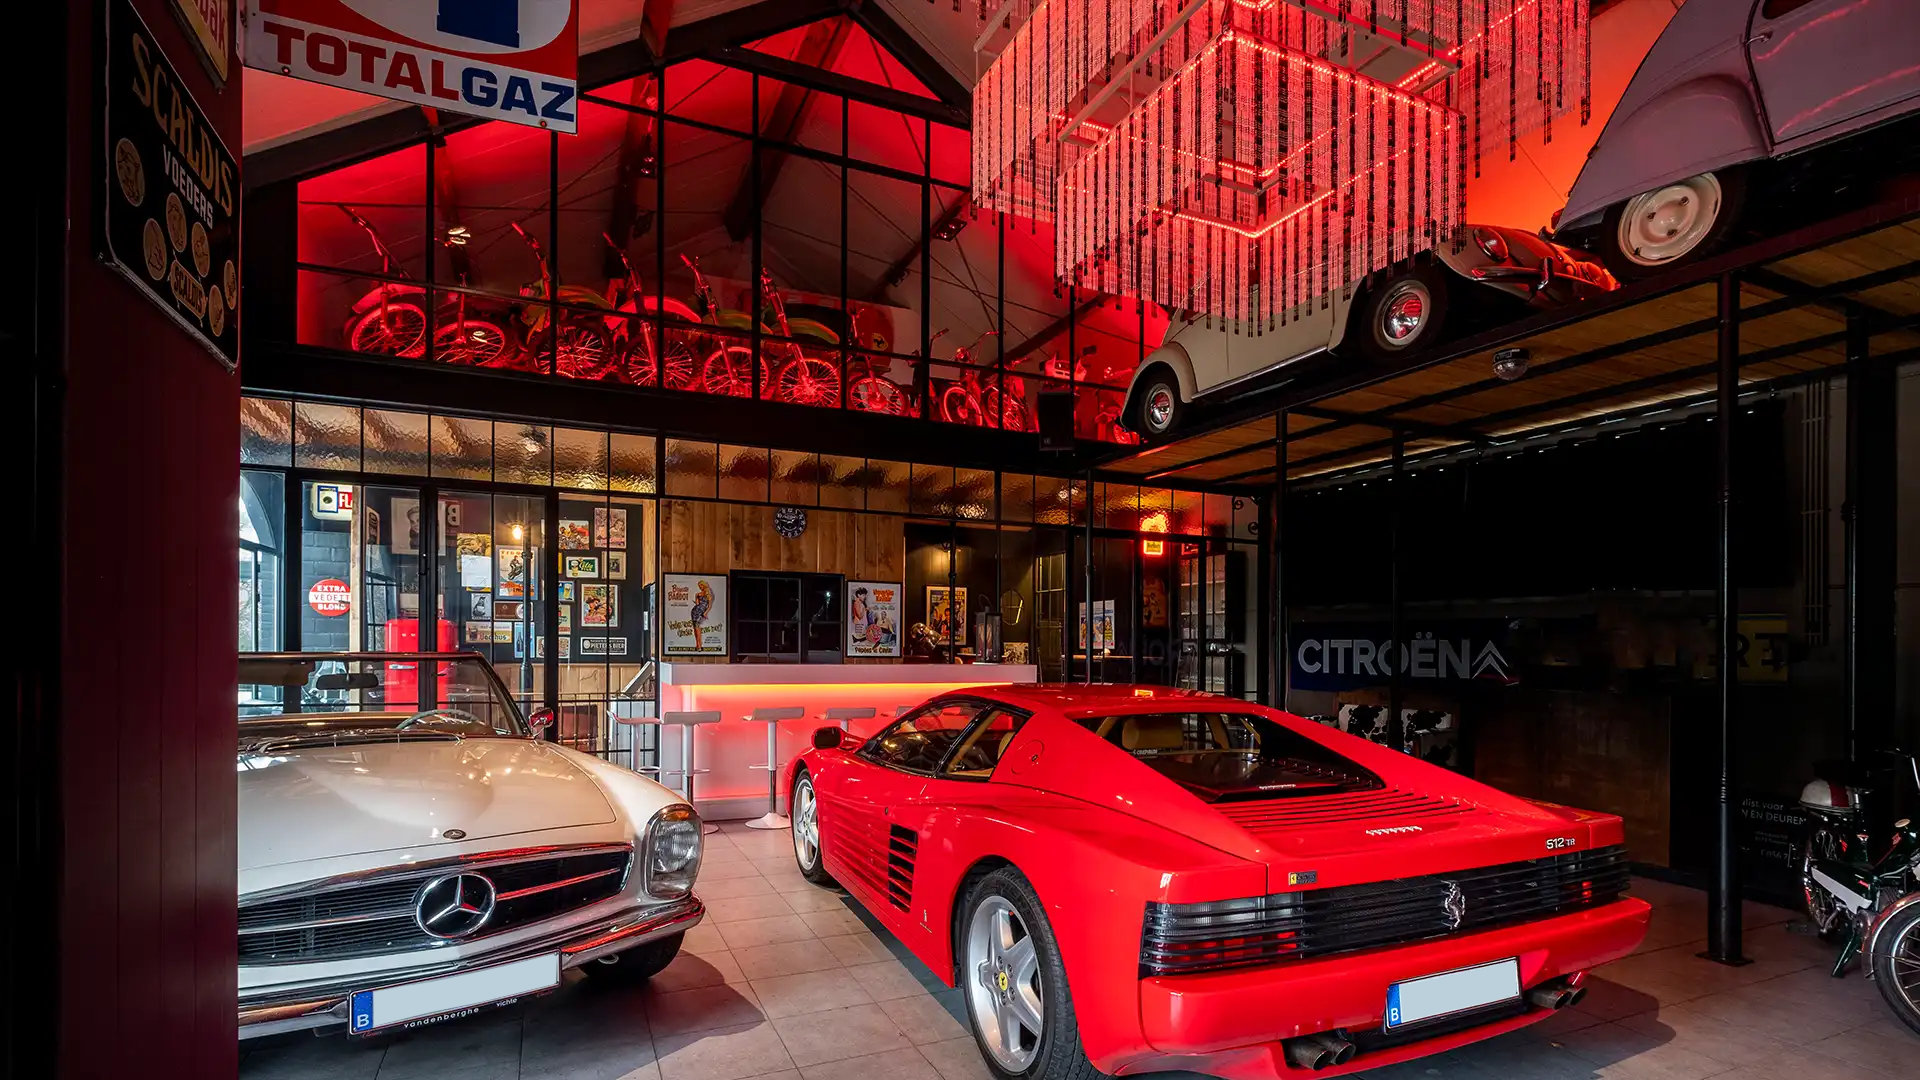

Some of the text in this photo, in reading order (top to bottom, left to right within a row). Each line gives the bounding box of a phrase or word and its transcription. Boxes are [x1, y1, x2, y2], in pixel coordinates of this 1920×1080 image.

[263, 20, 575, 122] TOTALGAZ
[132, 32, 233, 218] SCALDIS
[163, 144, 214, 231] VOEDERS
[1297, 631, 1471, 679] CITROËN
[1546, 837, 1576, 850] 512 TR
[357, 1013, 370, 1029] B
[403, 1007, 480, 1029] vandenberghe
[1390, 1007, 1400, 1022] B
